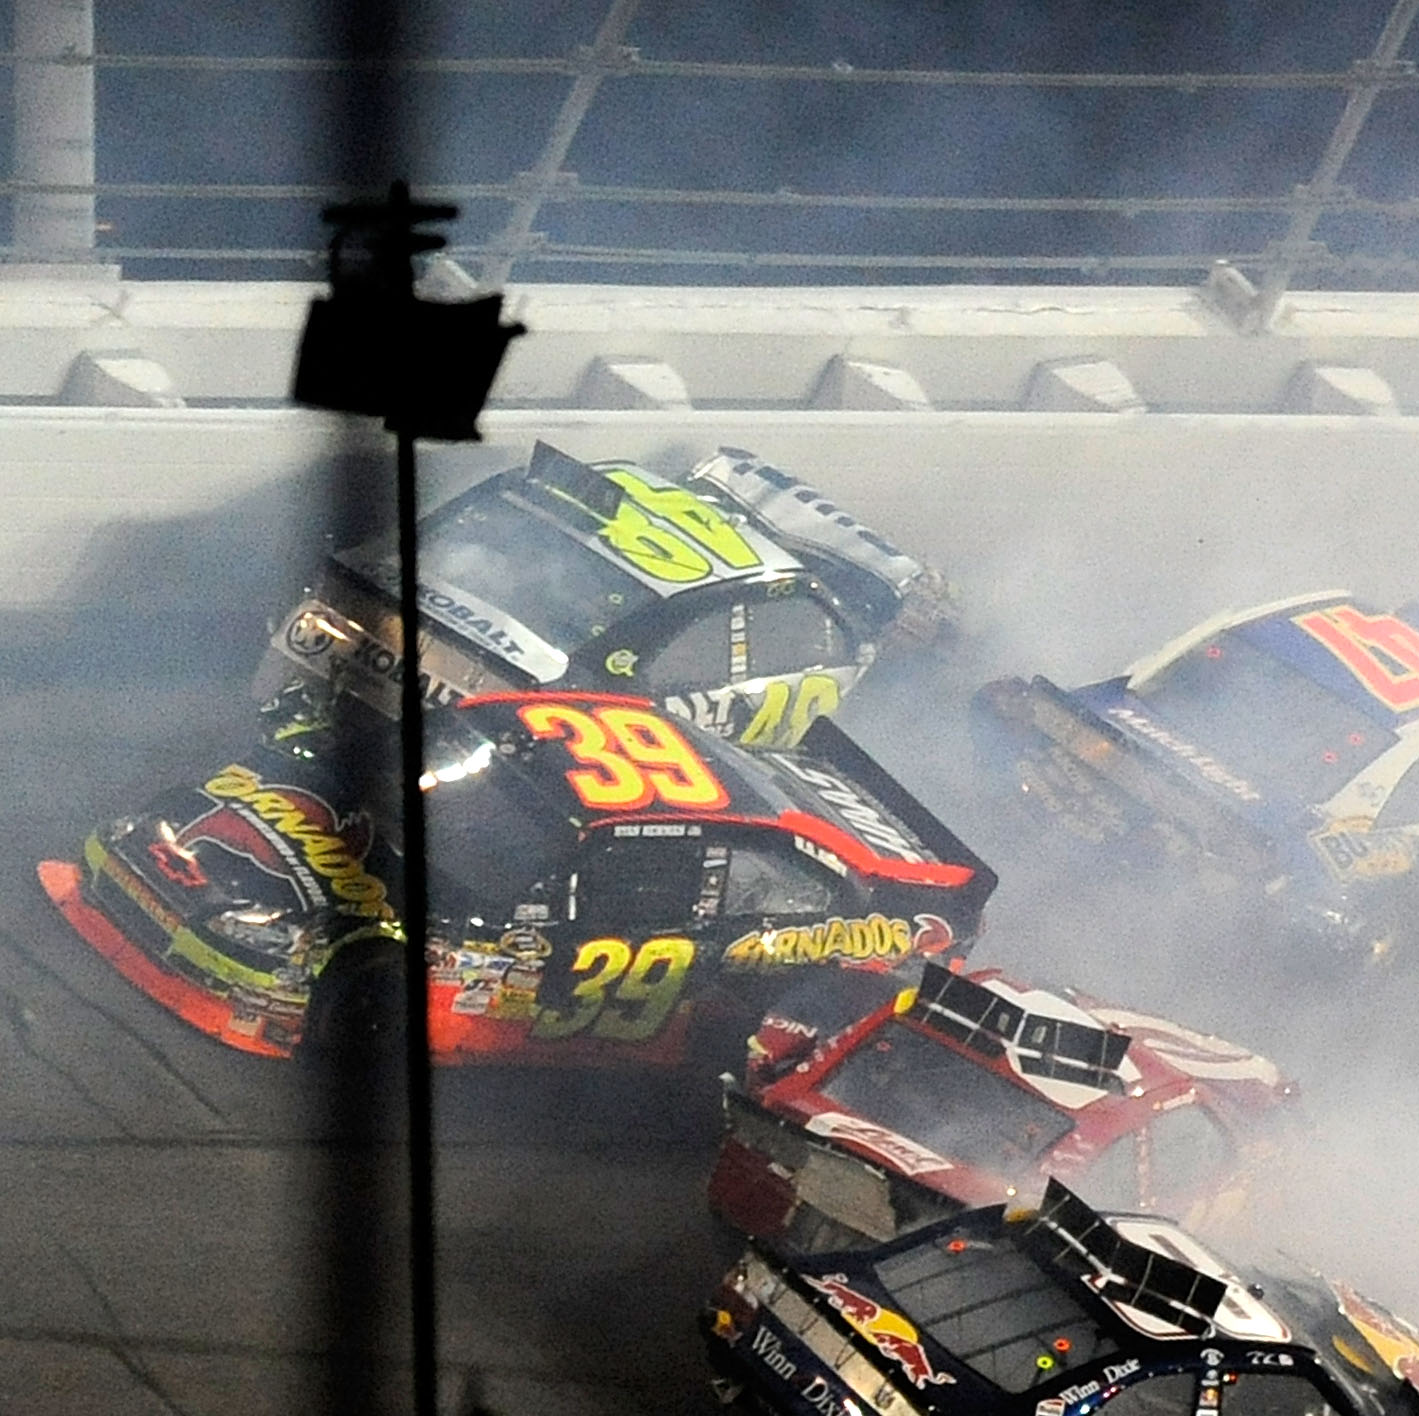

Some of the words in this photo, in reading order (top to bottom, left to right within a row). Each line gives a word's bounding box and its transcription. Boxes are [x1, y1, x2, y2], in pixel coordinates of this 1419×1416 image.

[516, 704, 731, 812] 39
[530, 936, 698, 1041] 39
[751, 1325, 798, 1380] Winn
[1058, 1380, 1101, 1405] Winn
